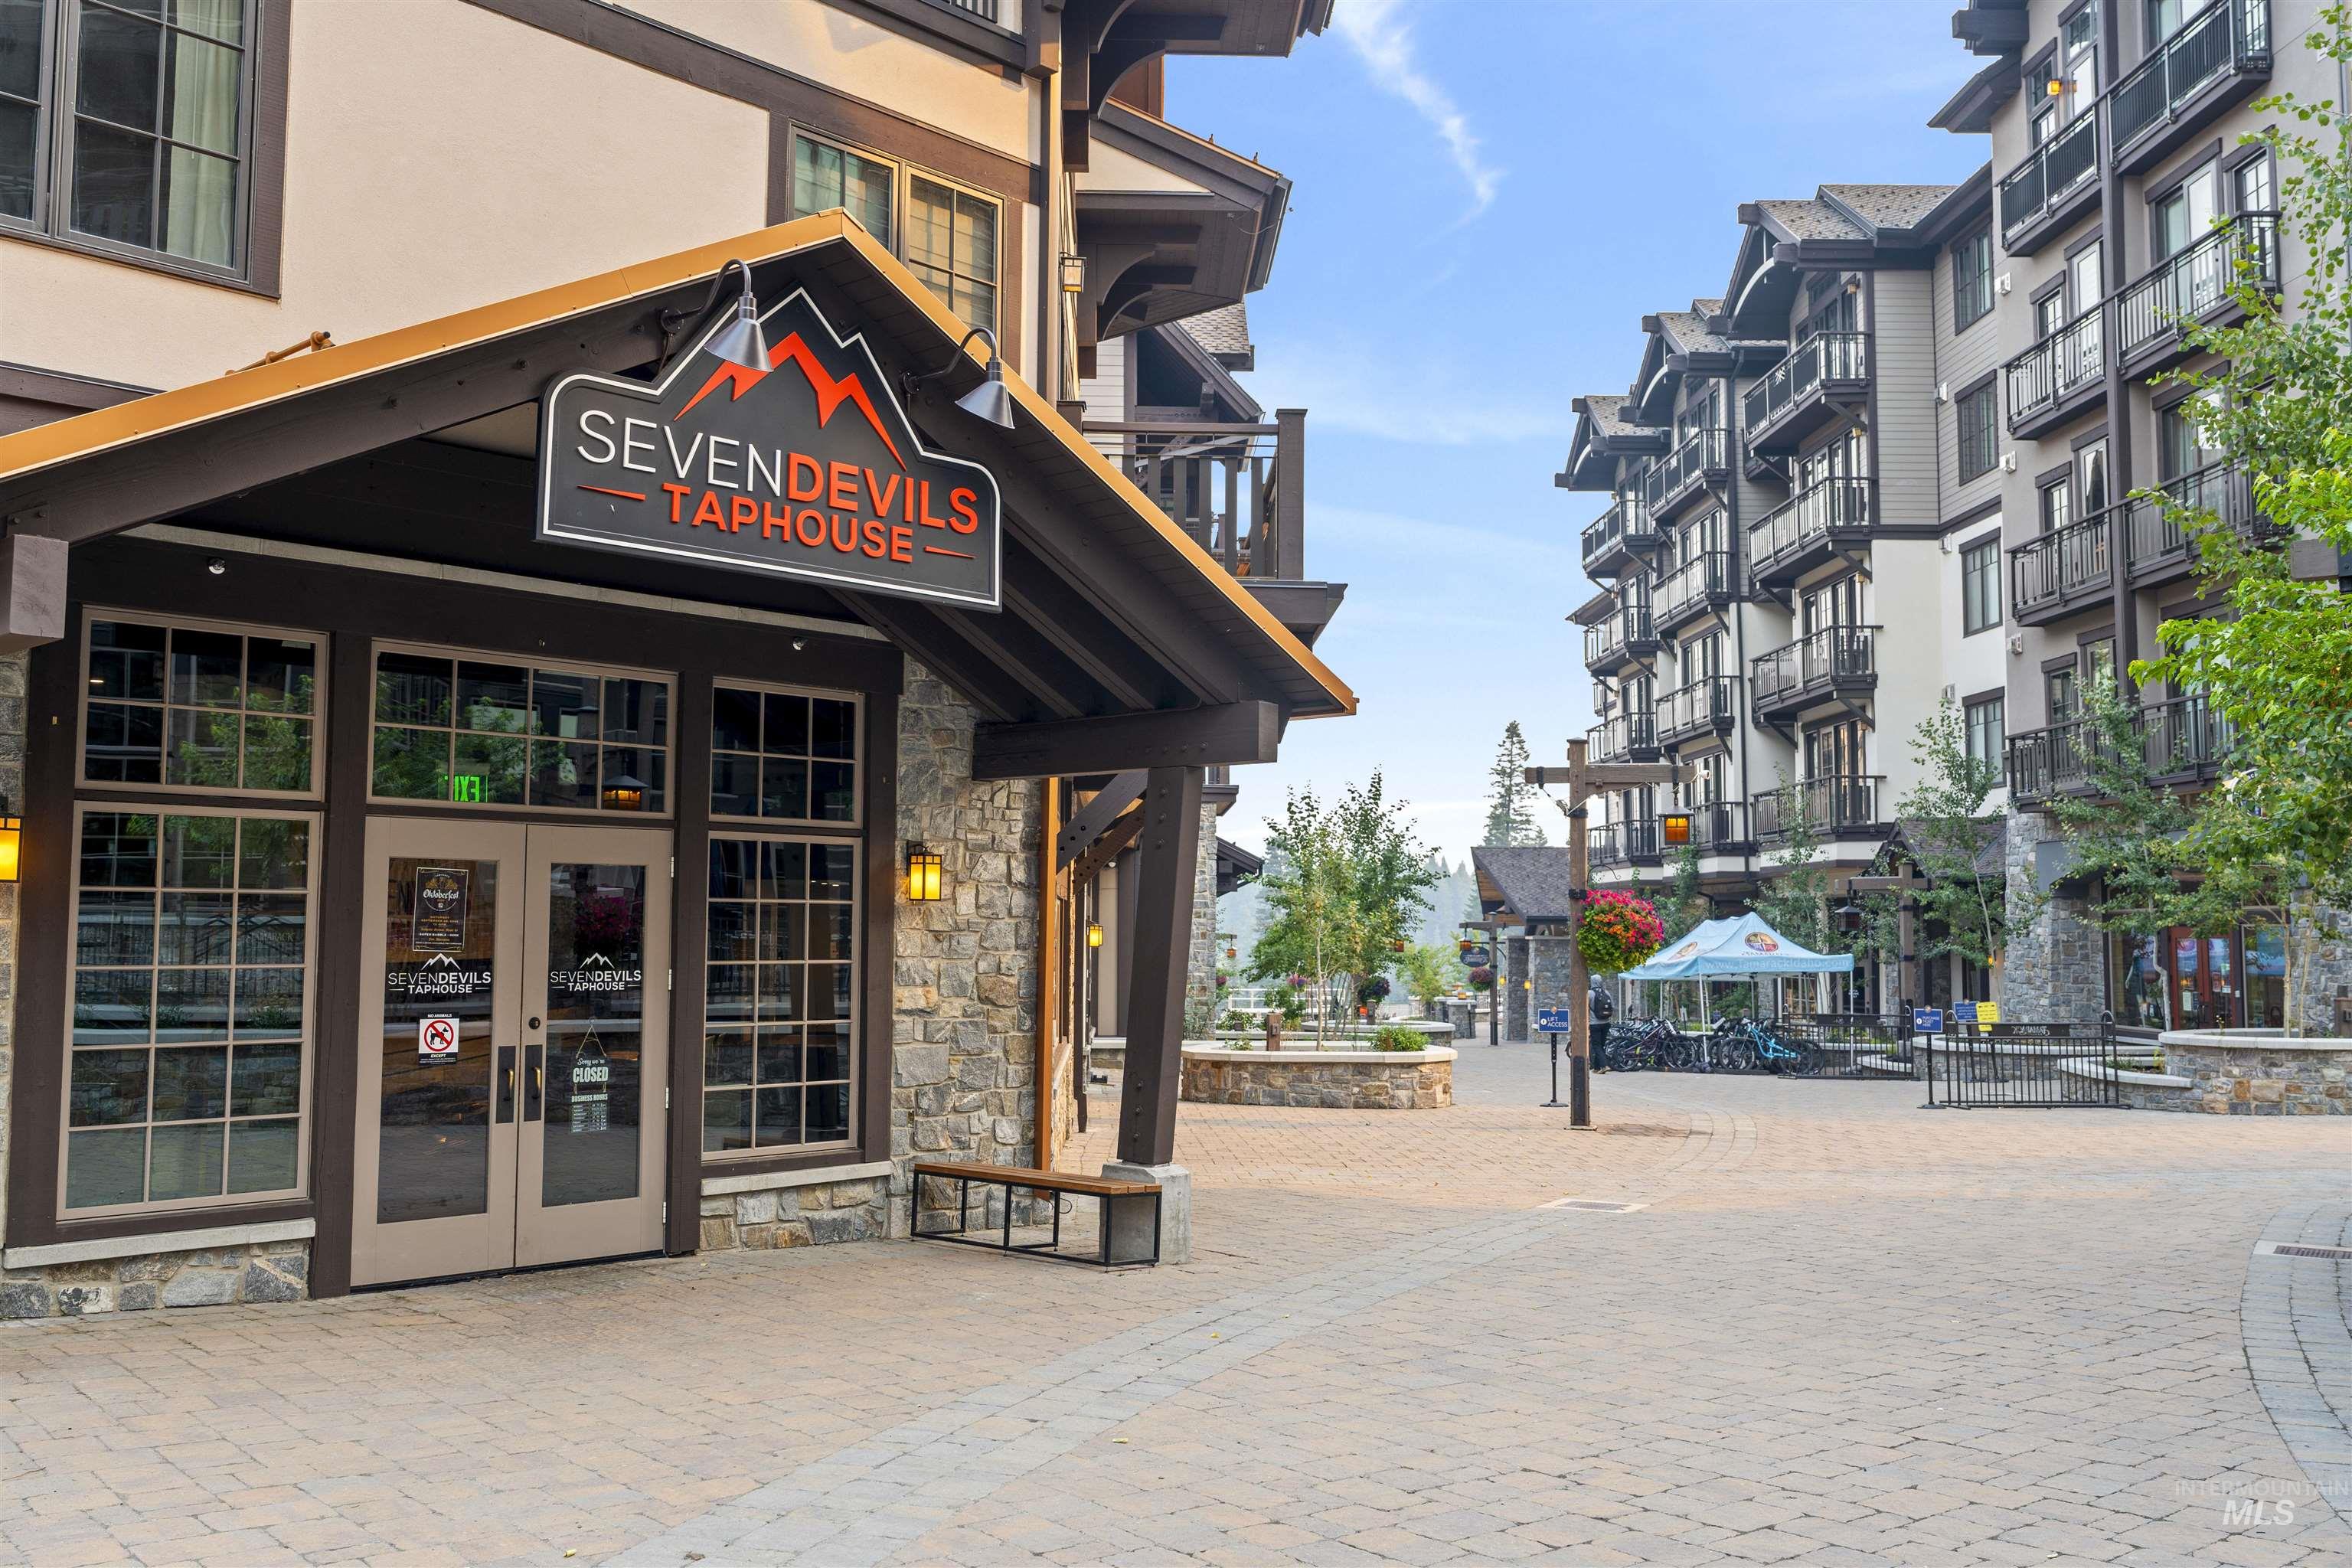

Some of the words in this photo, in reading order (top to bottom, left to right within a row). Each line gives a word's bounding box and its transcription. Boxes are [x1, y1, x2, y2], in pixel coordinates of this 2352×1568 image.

[662, 482, 913, 564] TAPHOUSE
[423, 889, 459, 901] Oktoberfest
[407, 984, 472, 994] TAPHOUSE
[567, 982, 625, 991] TAPHOUSE
[573, 1067, 609, 1083] CLOSED
